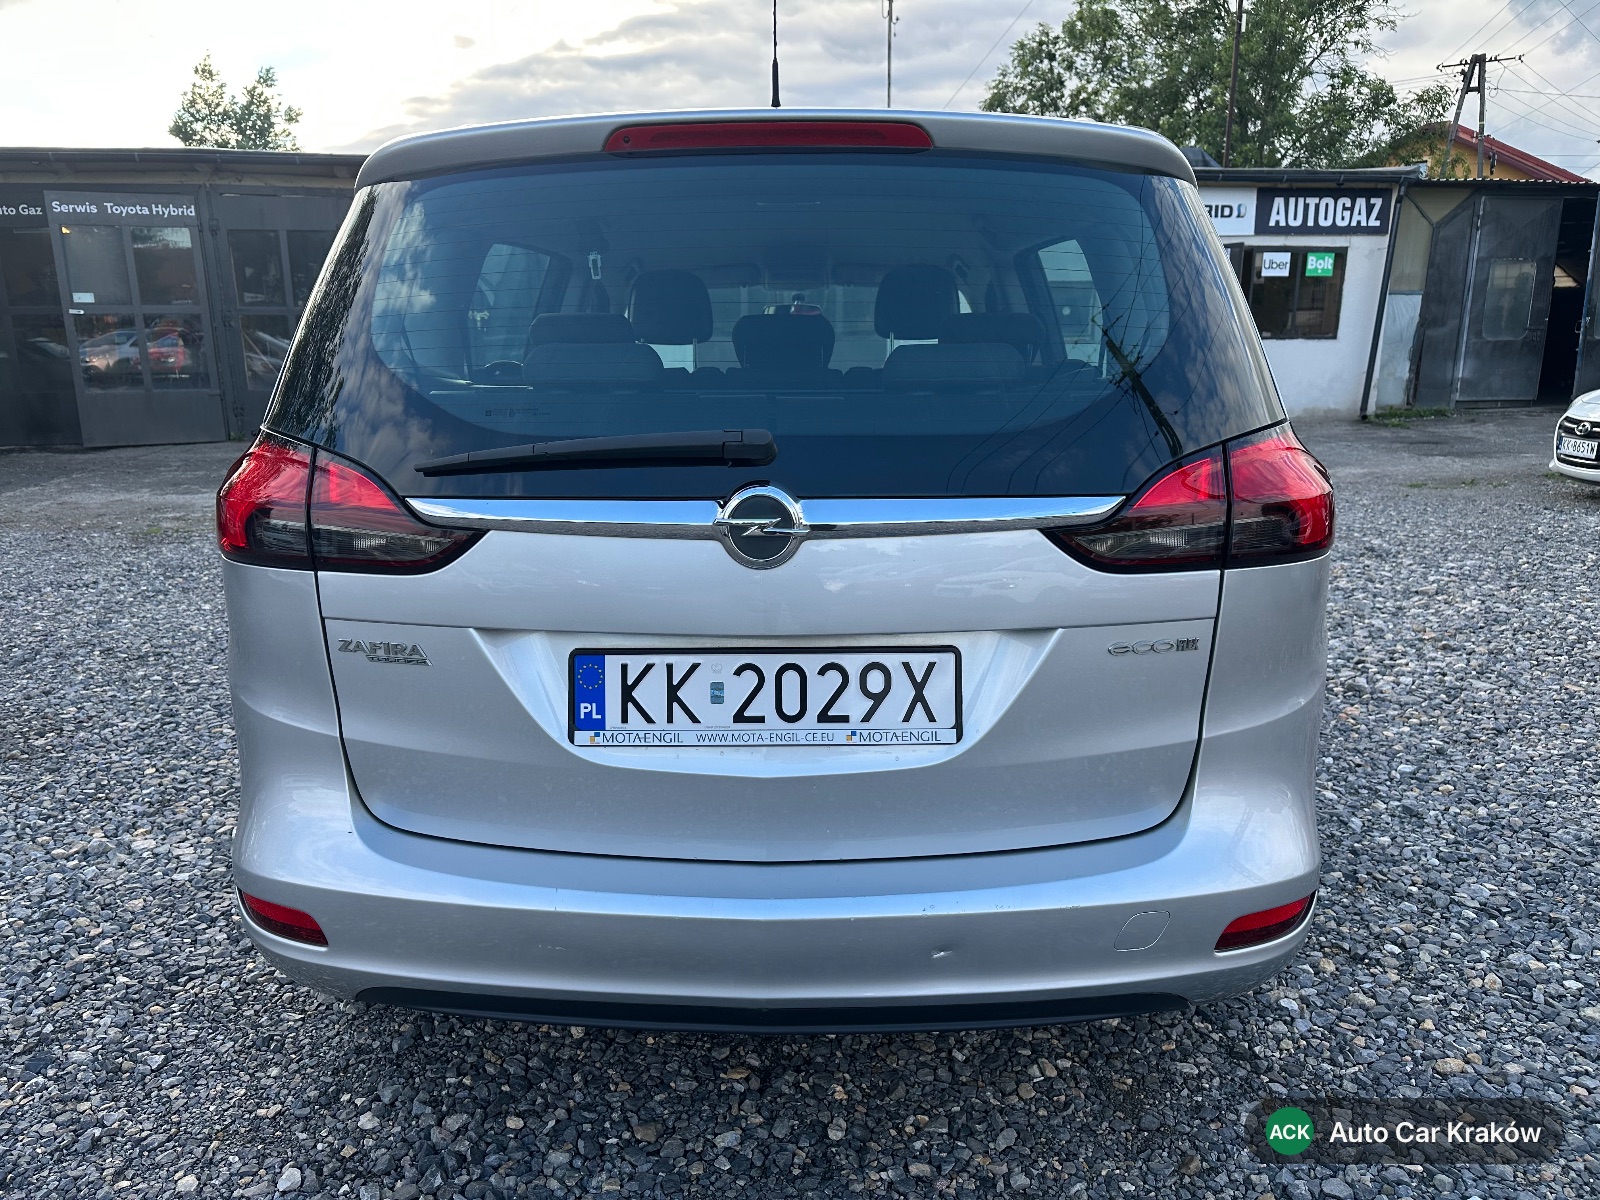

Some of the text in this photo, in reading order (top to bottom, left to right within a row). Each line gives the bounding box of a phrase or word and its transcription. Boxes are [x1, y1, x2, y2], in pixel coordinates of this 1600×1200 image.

[19, 204, 43, 215] Gaz
[51, 201, 196, 218] Serwis Toyota Hybrid
[1268, 196, 1383, 227] AUTOGAZ
[1263, 259, 1289, 270] Uber
[1307, 256, 1333, 271] Bolt
[338, 638, 428, 657] ZAFIRA
[620, 661, 937, 724] KK 2029X
[580, 702, 602, 719] PL
[696, 732, 835, 743] WWW.MOTA-ENGIL-CE.EU
